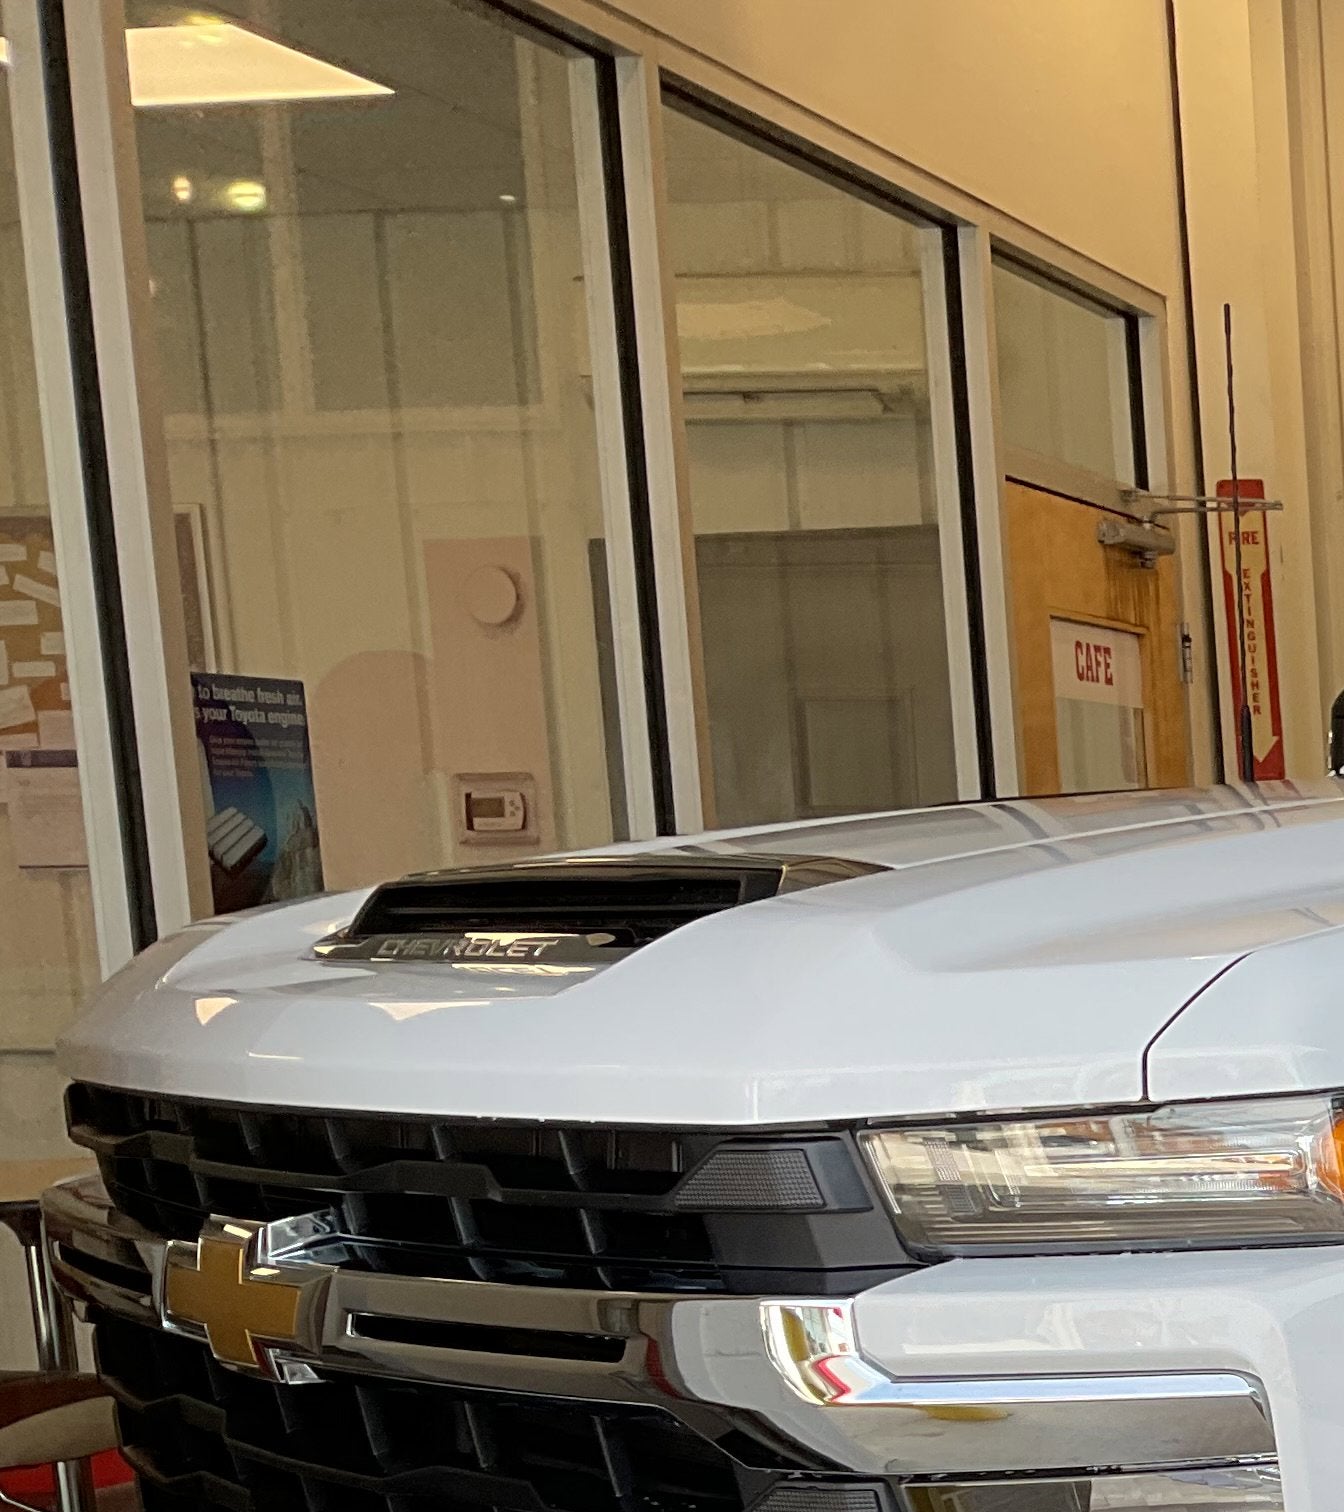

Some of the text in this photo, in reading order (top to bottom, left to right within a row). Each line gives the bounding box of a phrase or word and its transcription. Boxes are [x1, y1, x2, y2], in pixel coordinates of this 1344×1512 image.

[1228, 531, 1260, 545] FRE
[1242, 567, 1262, 716] EXTINGUISHER
[1074, 640, 1114, 687] CAFE
[197, 683, 211, 701] to
[212, 683, 255, 703] breathe
[256, 686, 285, 705] fresh
[201, 707, 228, 723] your
[228, 705, 266, 725] Toyota
[377, 938, 560, 957] CHEVROLET
